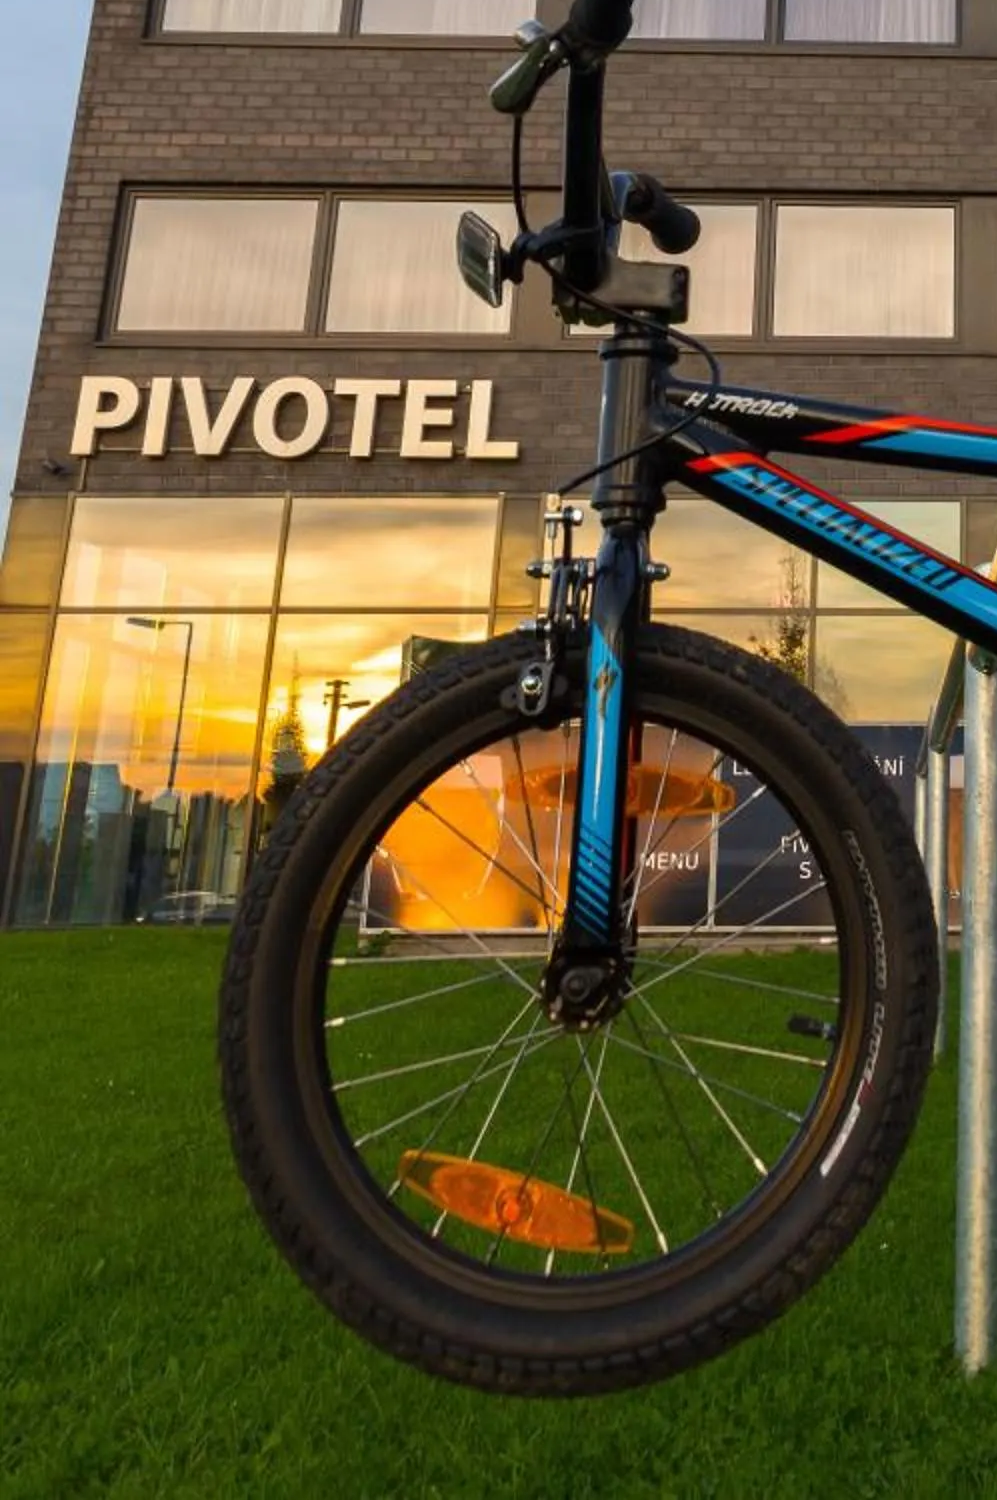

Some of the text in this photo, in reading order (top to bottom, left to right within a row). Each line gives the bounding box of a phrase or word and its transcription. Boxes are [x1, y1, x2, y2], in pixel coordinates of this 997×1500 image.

[70, 375, 520, 460] PIVOTEL
[731, 465, 964, 591] SPECIALIZED
[640, 851, 699, 870] MENU
